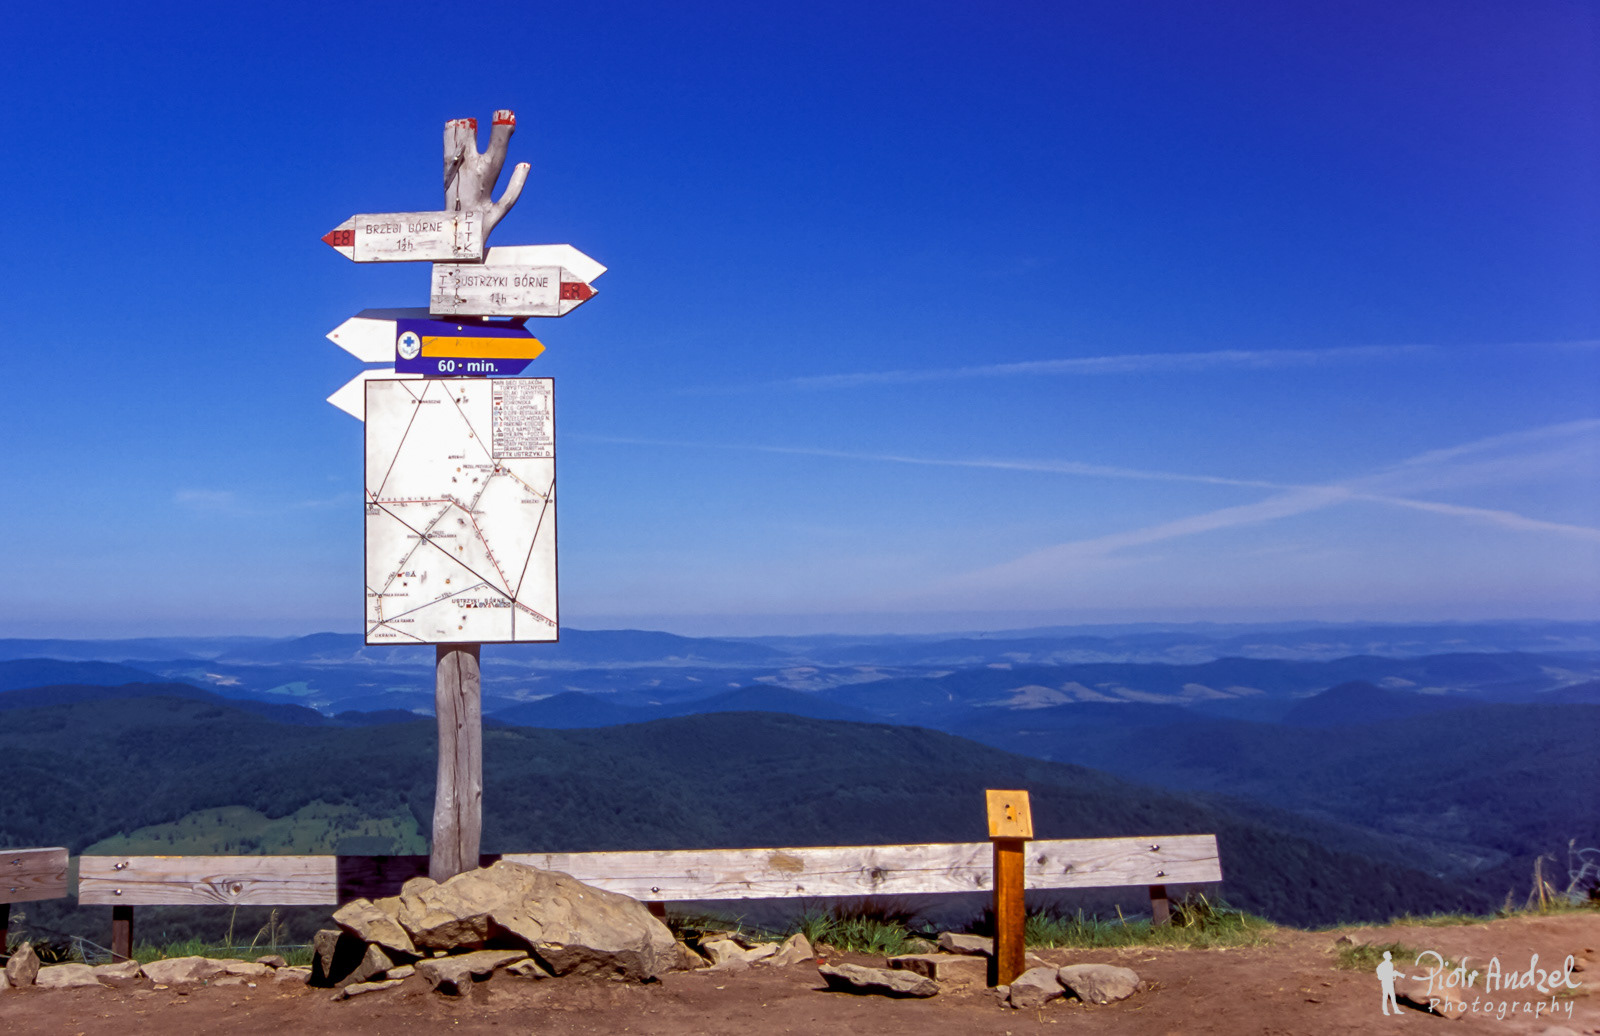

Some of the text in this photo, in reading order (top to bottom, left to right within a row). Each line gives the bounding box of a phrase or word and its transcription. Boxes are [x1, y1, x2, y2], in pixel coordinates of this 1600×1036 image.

[365, 219, 443, 235] BRZEGI GÓRNE
[333, 229, 350, 246] E8
[461, 274, 549, 288] USTRZYKI GÓRNE
[438, 360, 498, 372] 60 min.
